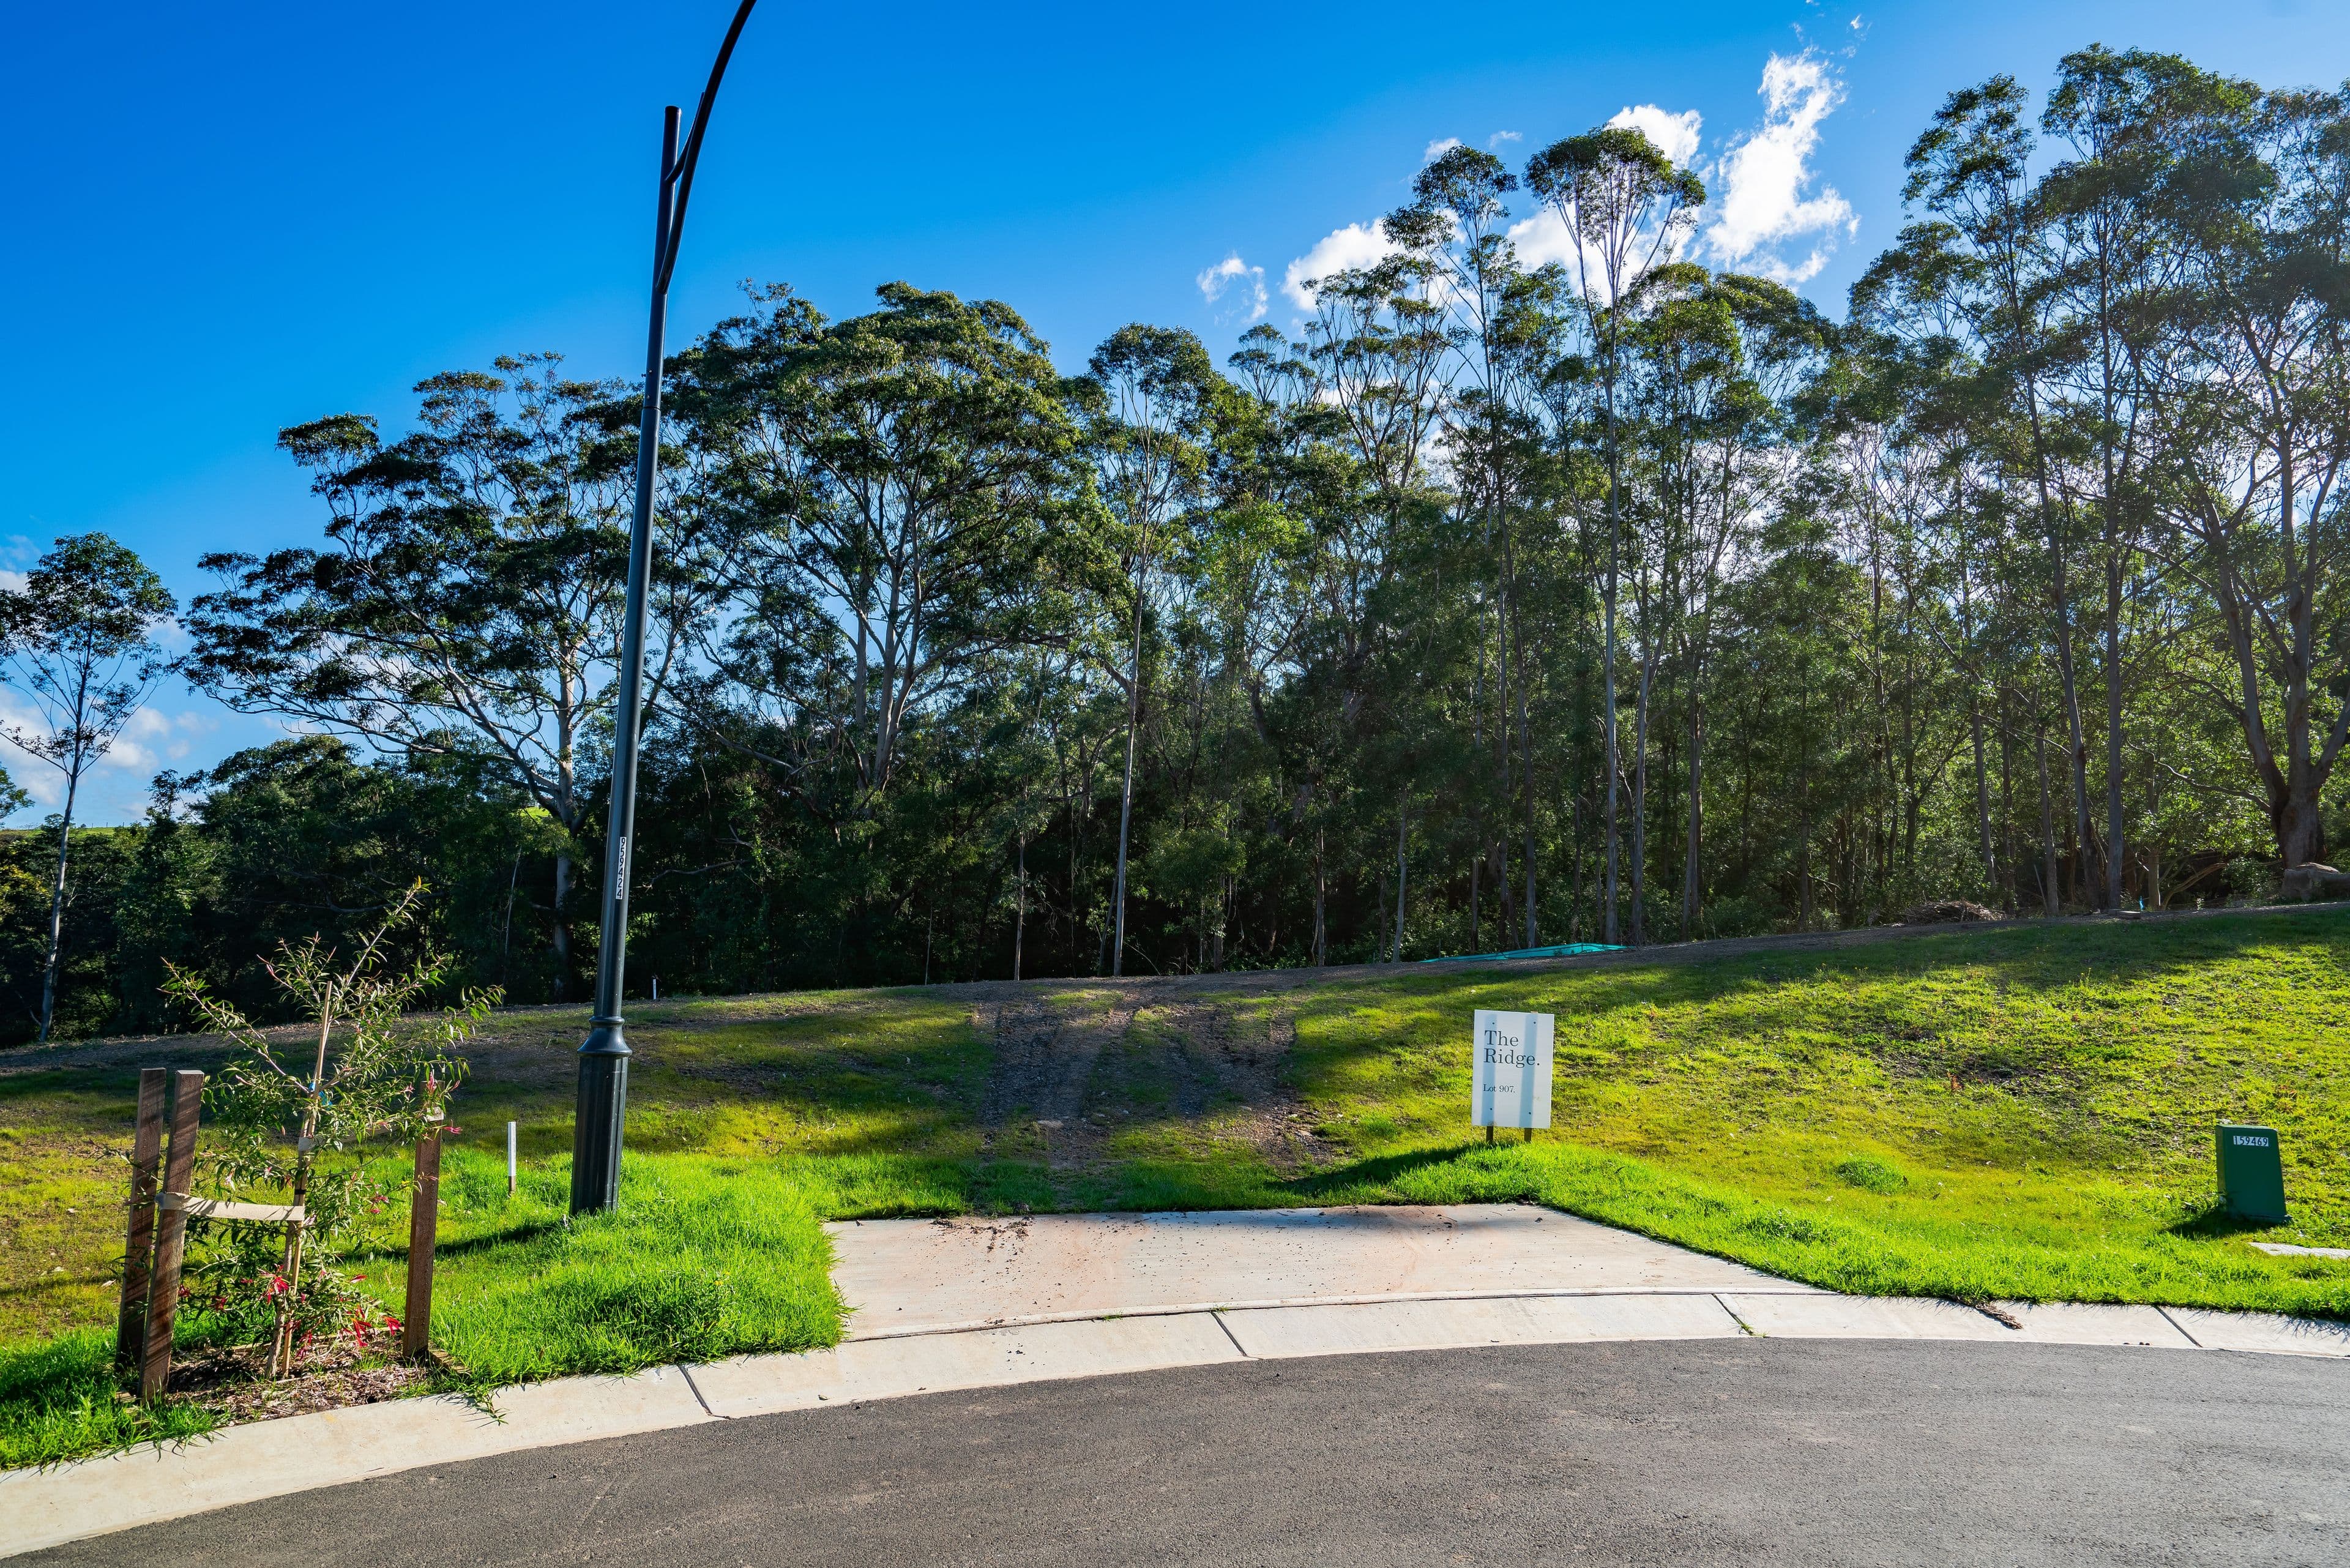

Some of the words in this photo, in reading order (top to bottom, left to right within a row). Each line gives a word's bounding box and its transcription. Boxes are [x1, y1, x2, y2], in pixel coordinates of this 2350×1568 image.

[617, 837, 625, 898] 959424
[1484, 1030, 1518, 1046] The
[1483, 1048, 1540, 1068] Ridge.
[2234, 1136, 2268, 1146] 159469
